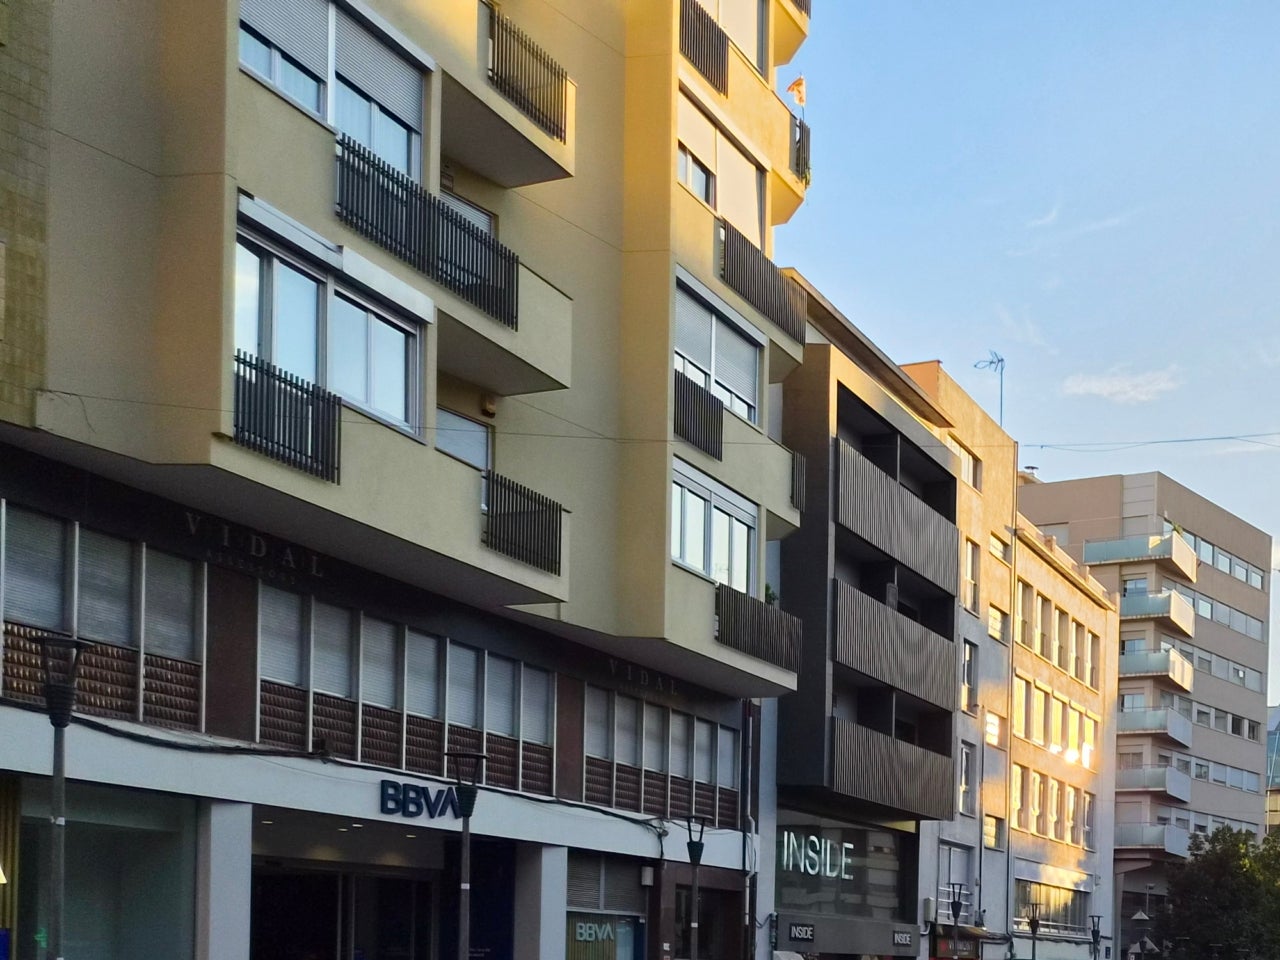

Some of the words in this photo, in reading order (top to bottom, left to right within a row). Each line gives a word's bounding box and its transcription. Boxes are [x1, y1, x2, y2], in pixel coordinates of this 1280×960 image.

[186, 512, 324, 577] VIDAL
[381, 779, 463, 819] BBVA
[783, 830, 855, 880] INSIDE
[575, 922, 614, 941] BBVA
[791, 926, 814, 940] INSIDE
[894, 933, 911, 945] INSIDE
